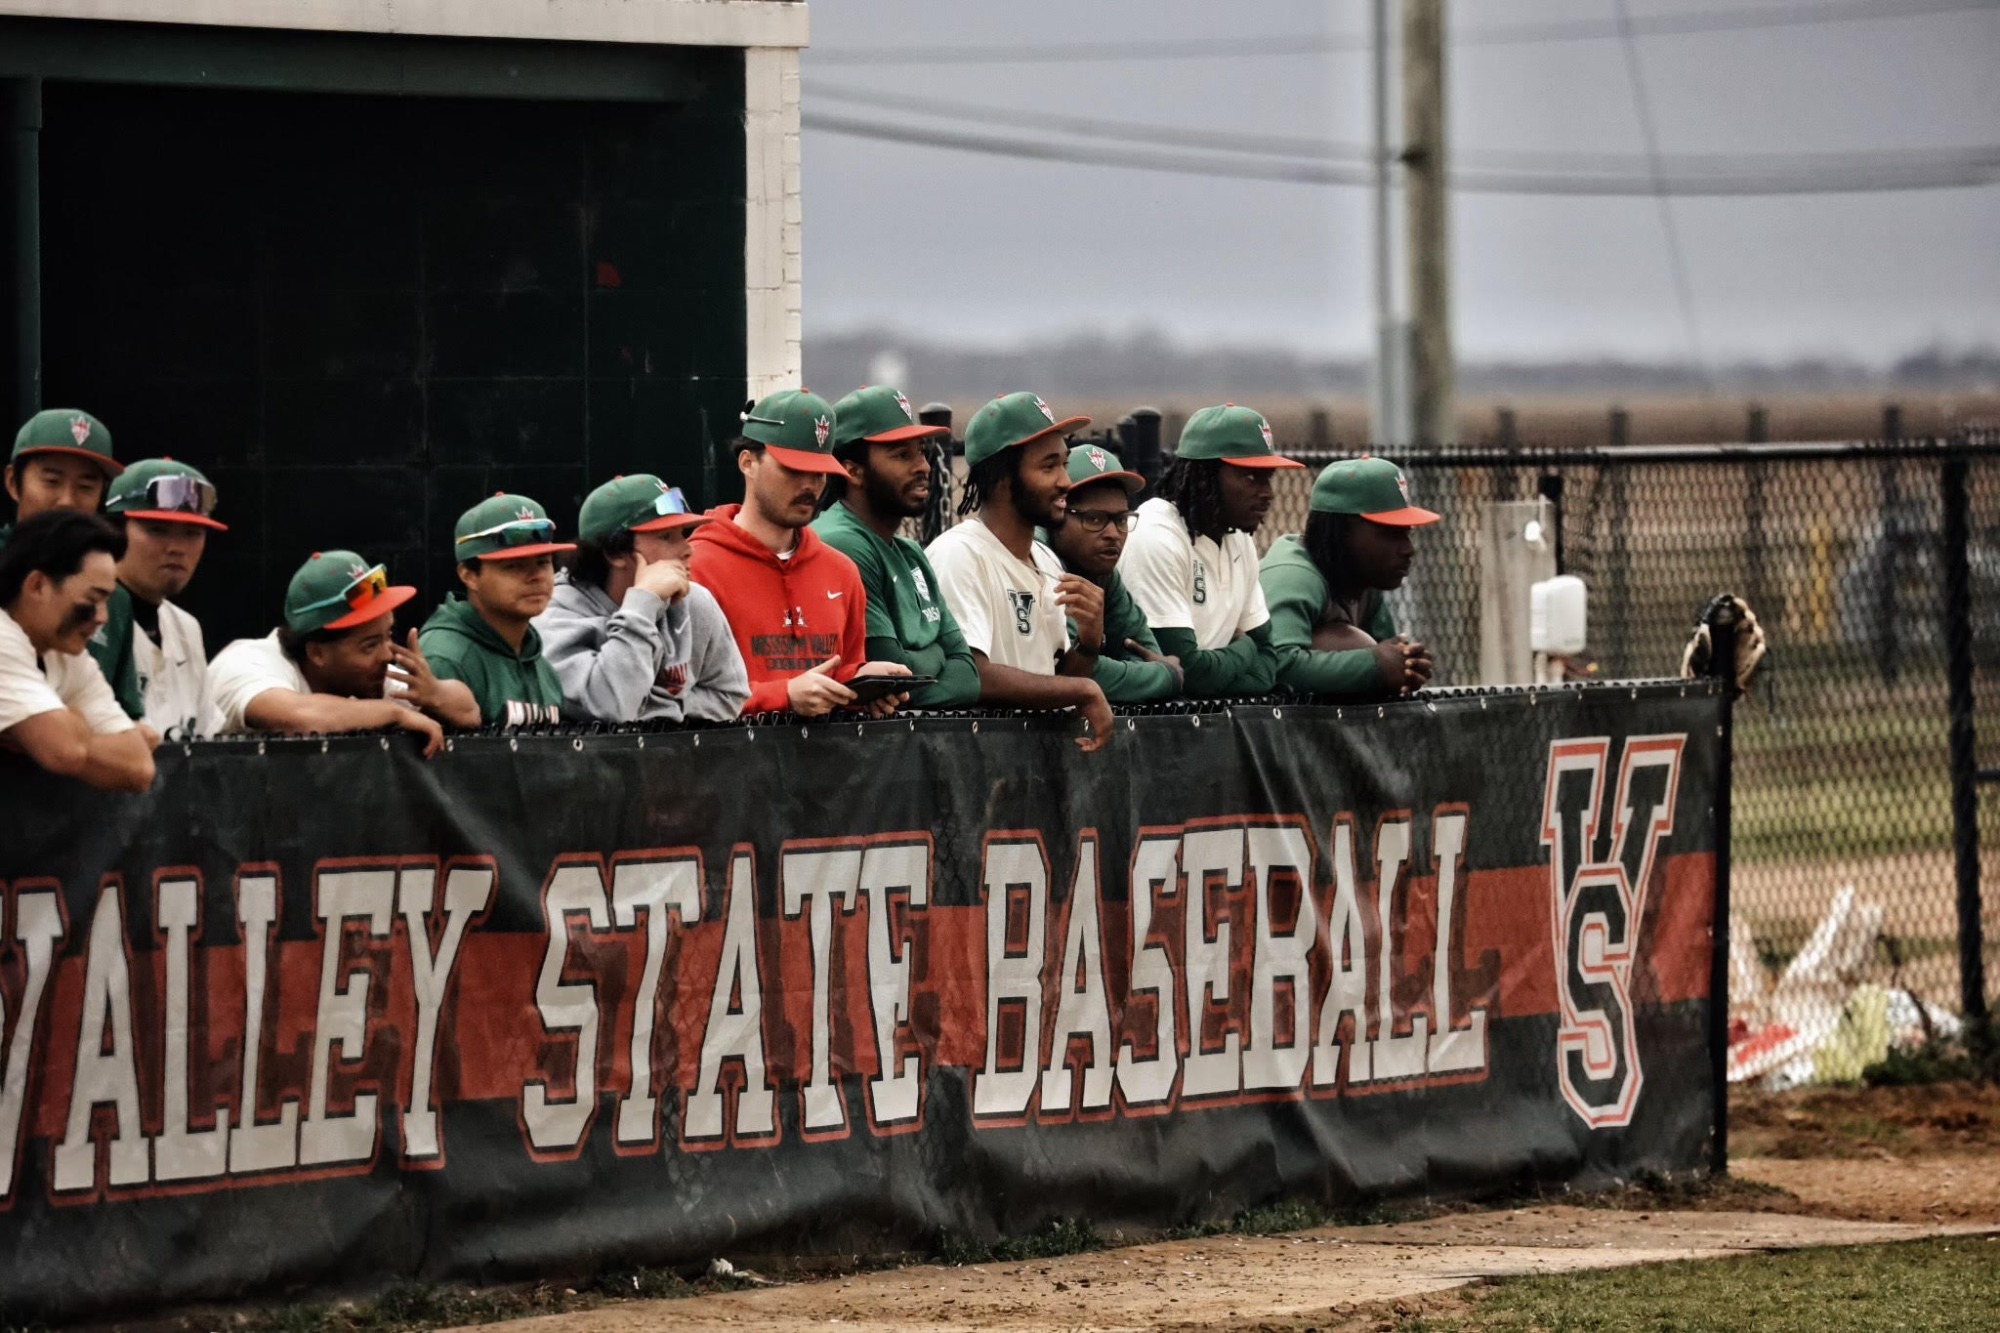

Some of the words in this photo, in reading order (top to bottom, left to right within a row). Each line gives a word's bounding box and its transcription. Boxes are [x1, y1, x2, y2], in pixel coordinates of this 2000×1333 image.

[517, 831, 934, 1163] STATE
[971, 802, 1490, 1129] BASEBALL
[1540, 733, 1688, 1130] VS
